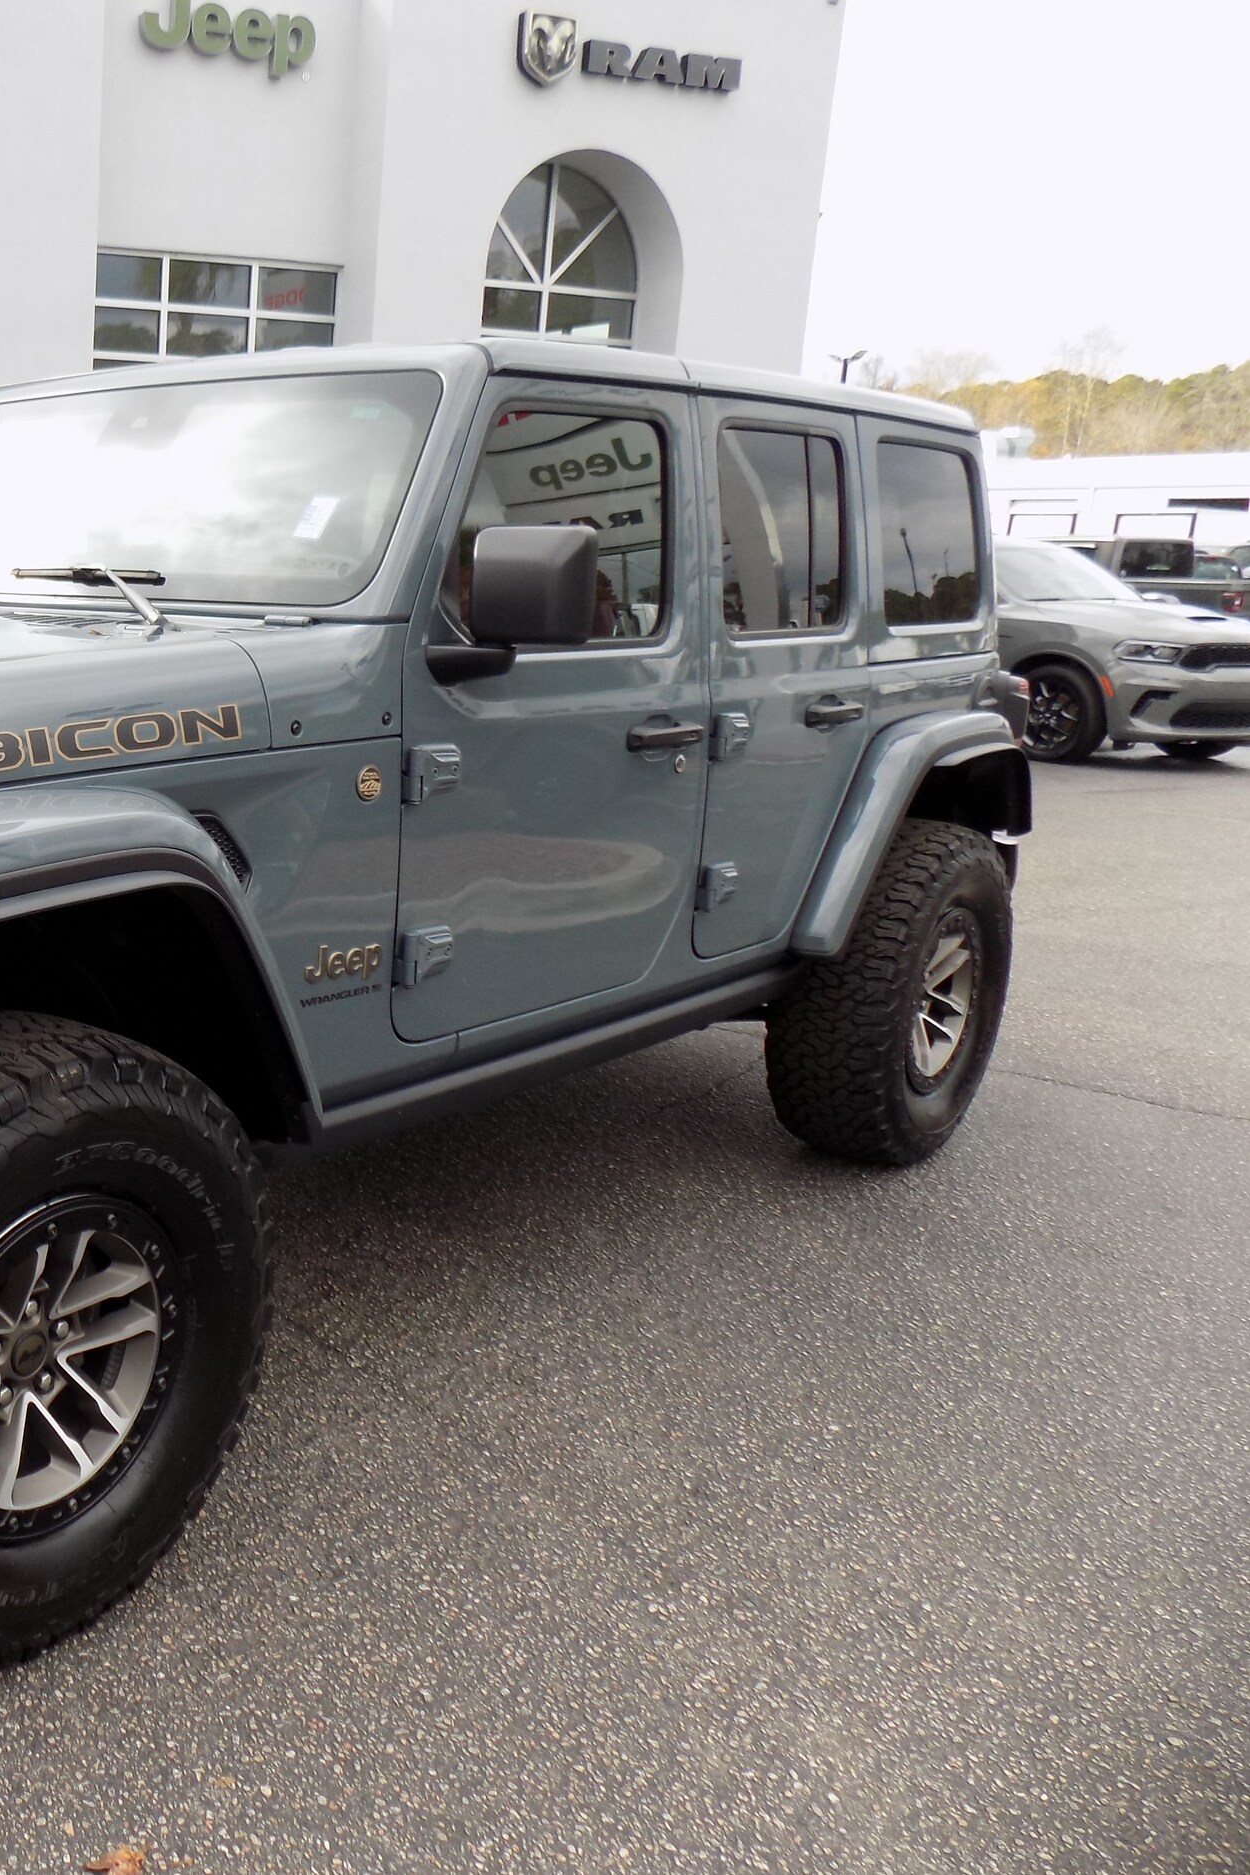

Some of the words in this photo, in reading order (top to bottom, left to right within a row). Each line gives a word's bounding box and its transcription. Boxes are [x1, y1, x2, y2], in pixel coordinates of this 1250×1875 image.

[139, 0, 316, 80] Jeep
[581, 39, 742, 93] RAM
[304, 943, 382, 985] Jeep
[299, 985, 370, 1008] WRANGLER
